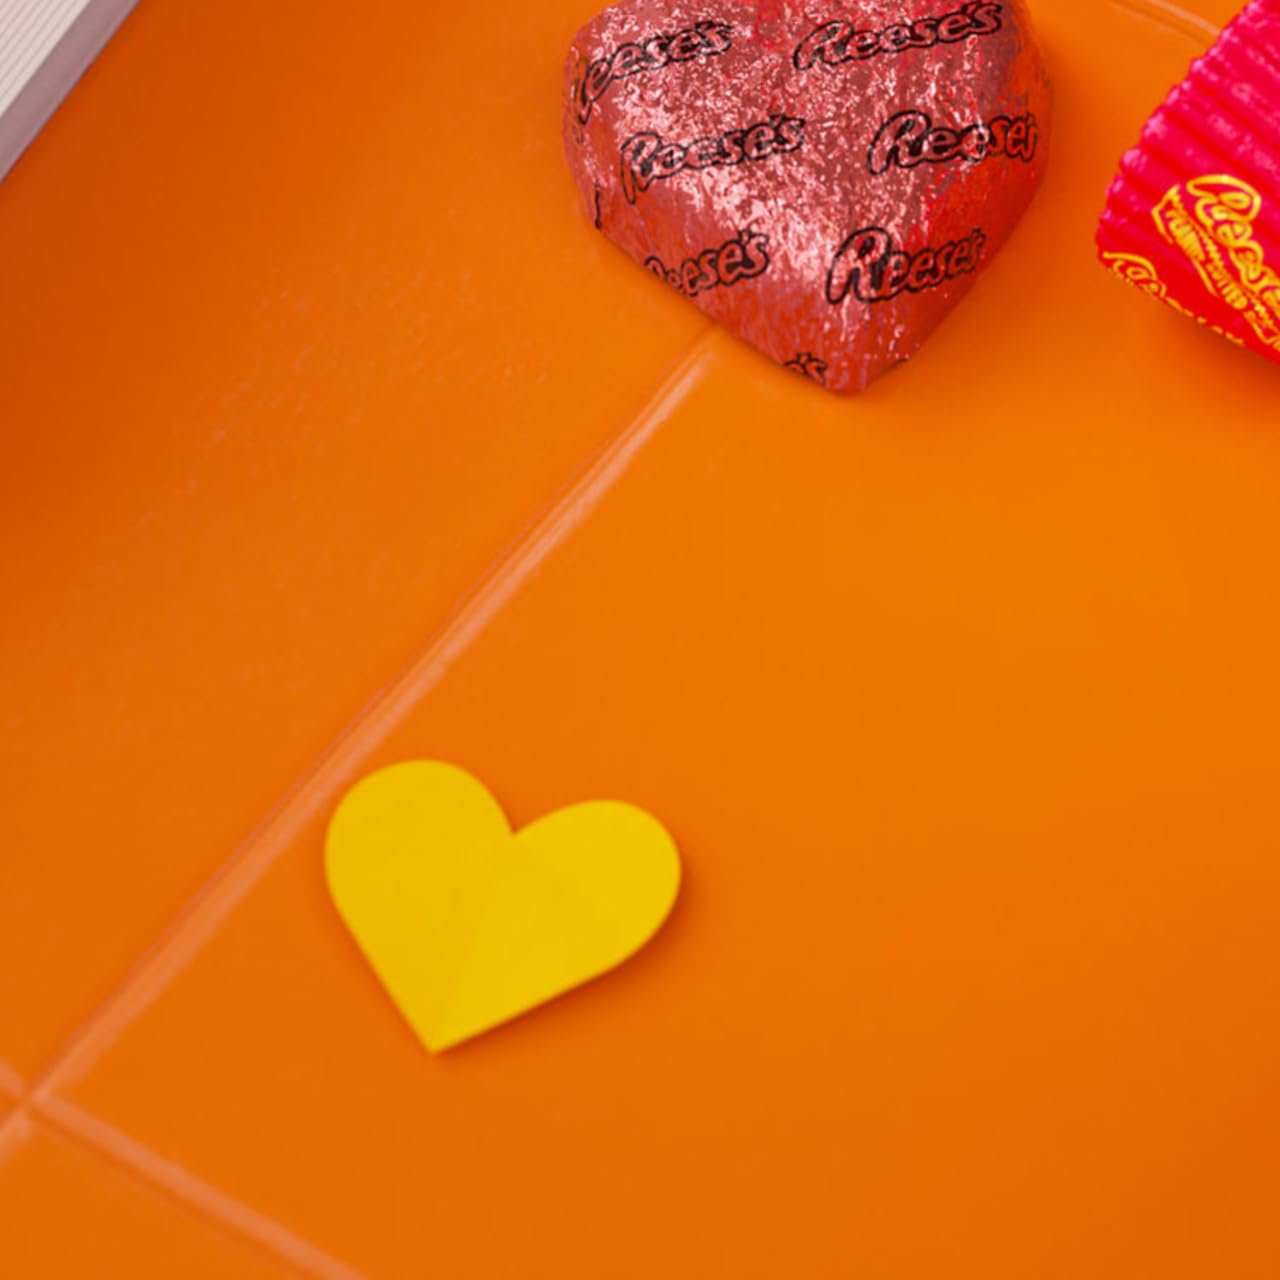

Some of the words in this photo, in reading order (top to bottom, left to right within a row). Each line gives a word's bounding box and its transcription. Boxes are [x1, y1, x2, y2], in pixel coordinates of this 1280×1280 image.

[793, 0, 1002, 71] Reese's
[620, 114, 806, 206] Reese's
[825, 226, 987, 306] Reese's
